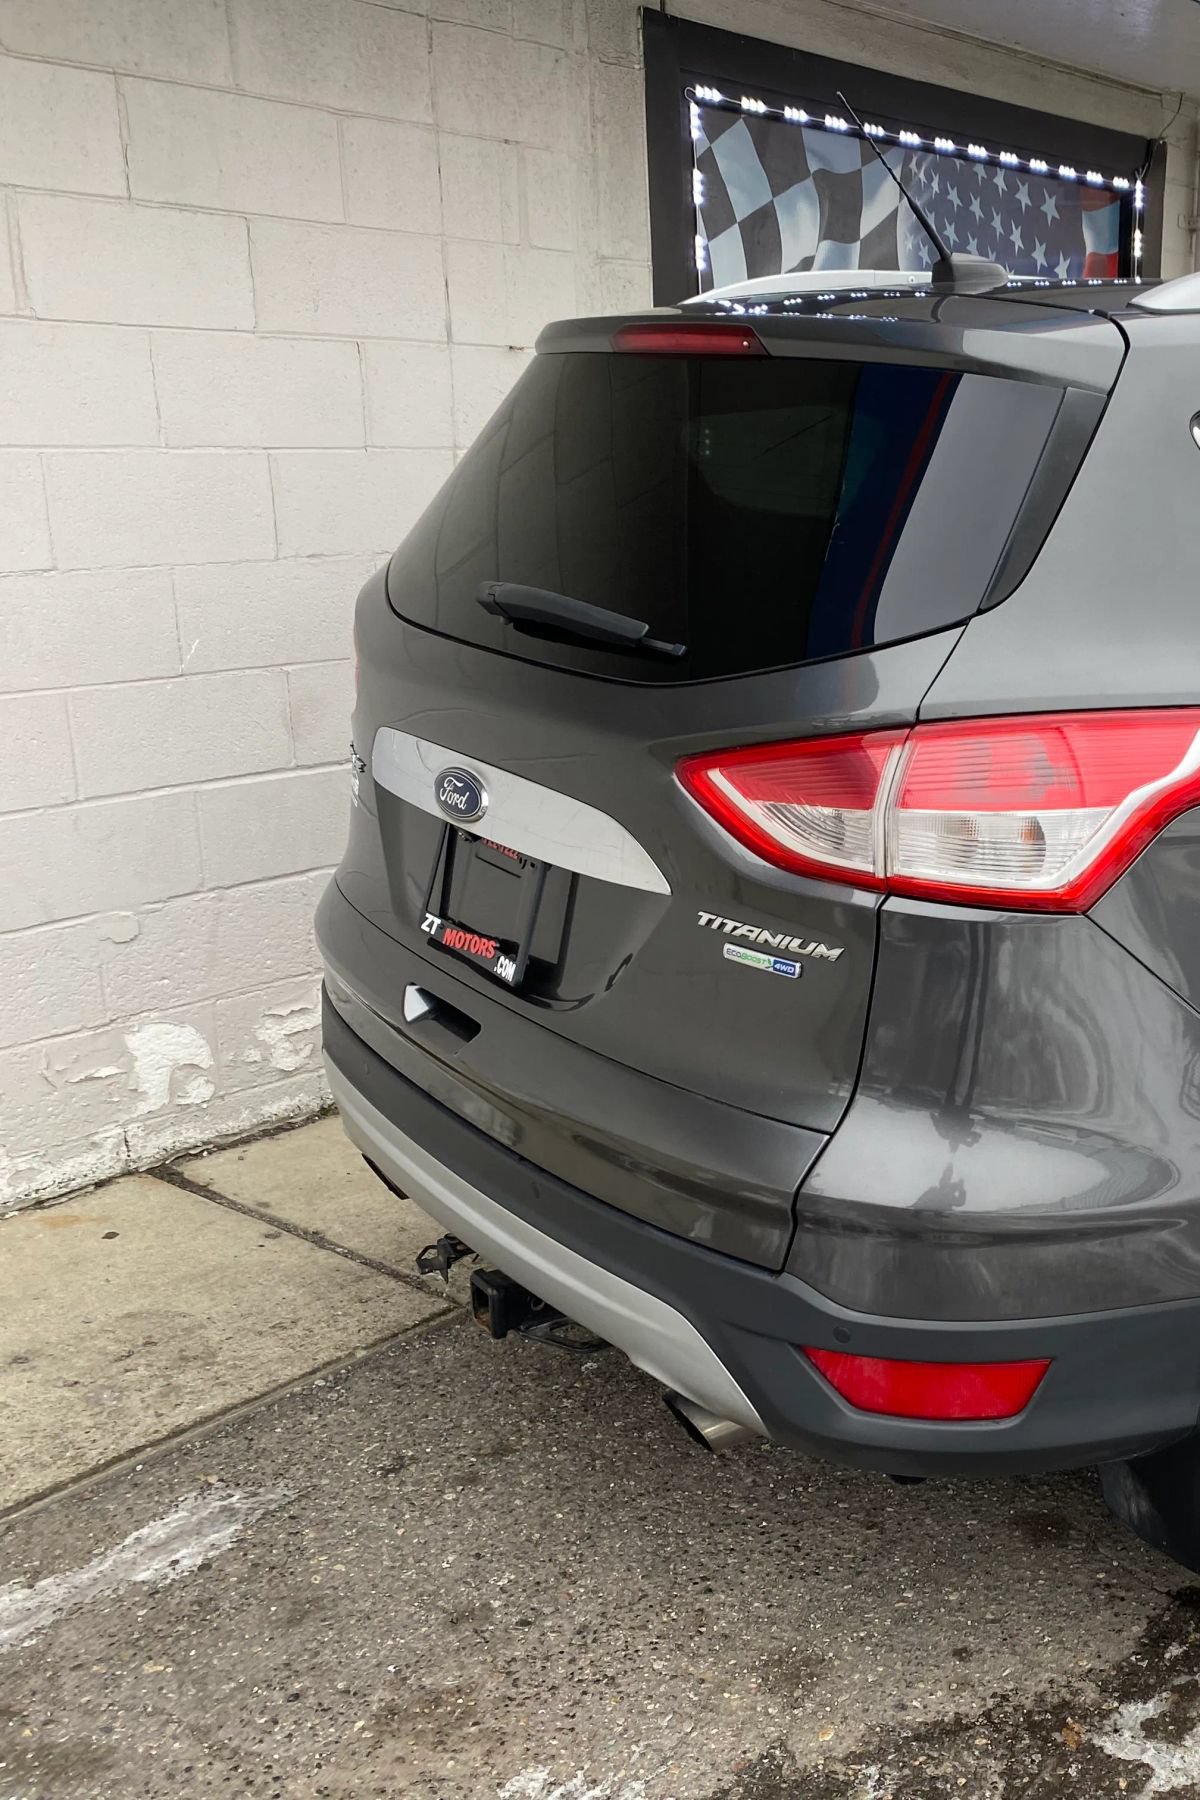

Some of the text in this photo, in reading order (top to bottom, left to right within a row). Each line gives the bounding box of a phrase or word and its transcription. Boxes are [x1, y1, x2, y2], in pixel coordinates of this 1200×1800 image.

[440, 776, 469, 810] Ford
[421, 913, 516, 982] ZT MOTORS .COM
[697, 911, 845, 962] TITANIUM
[774, 960, 795, 974] 4WD
